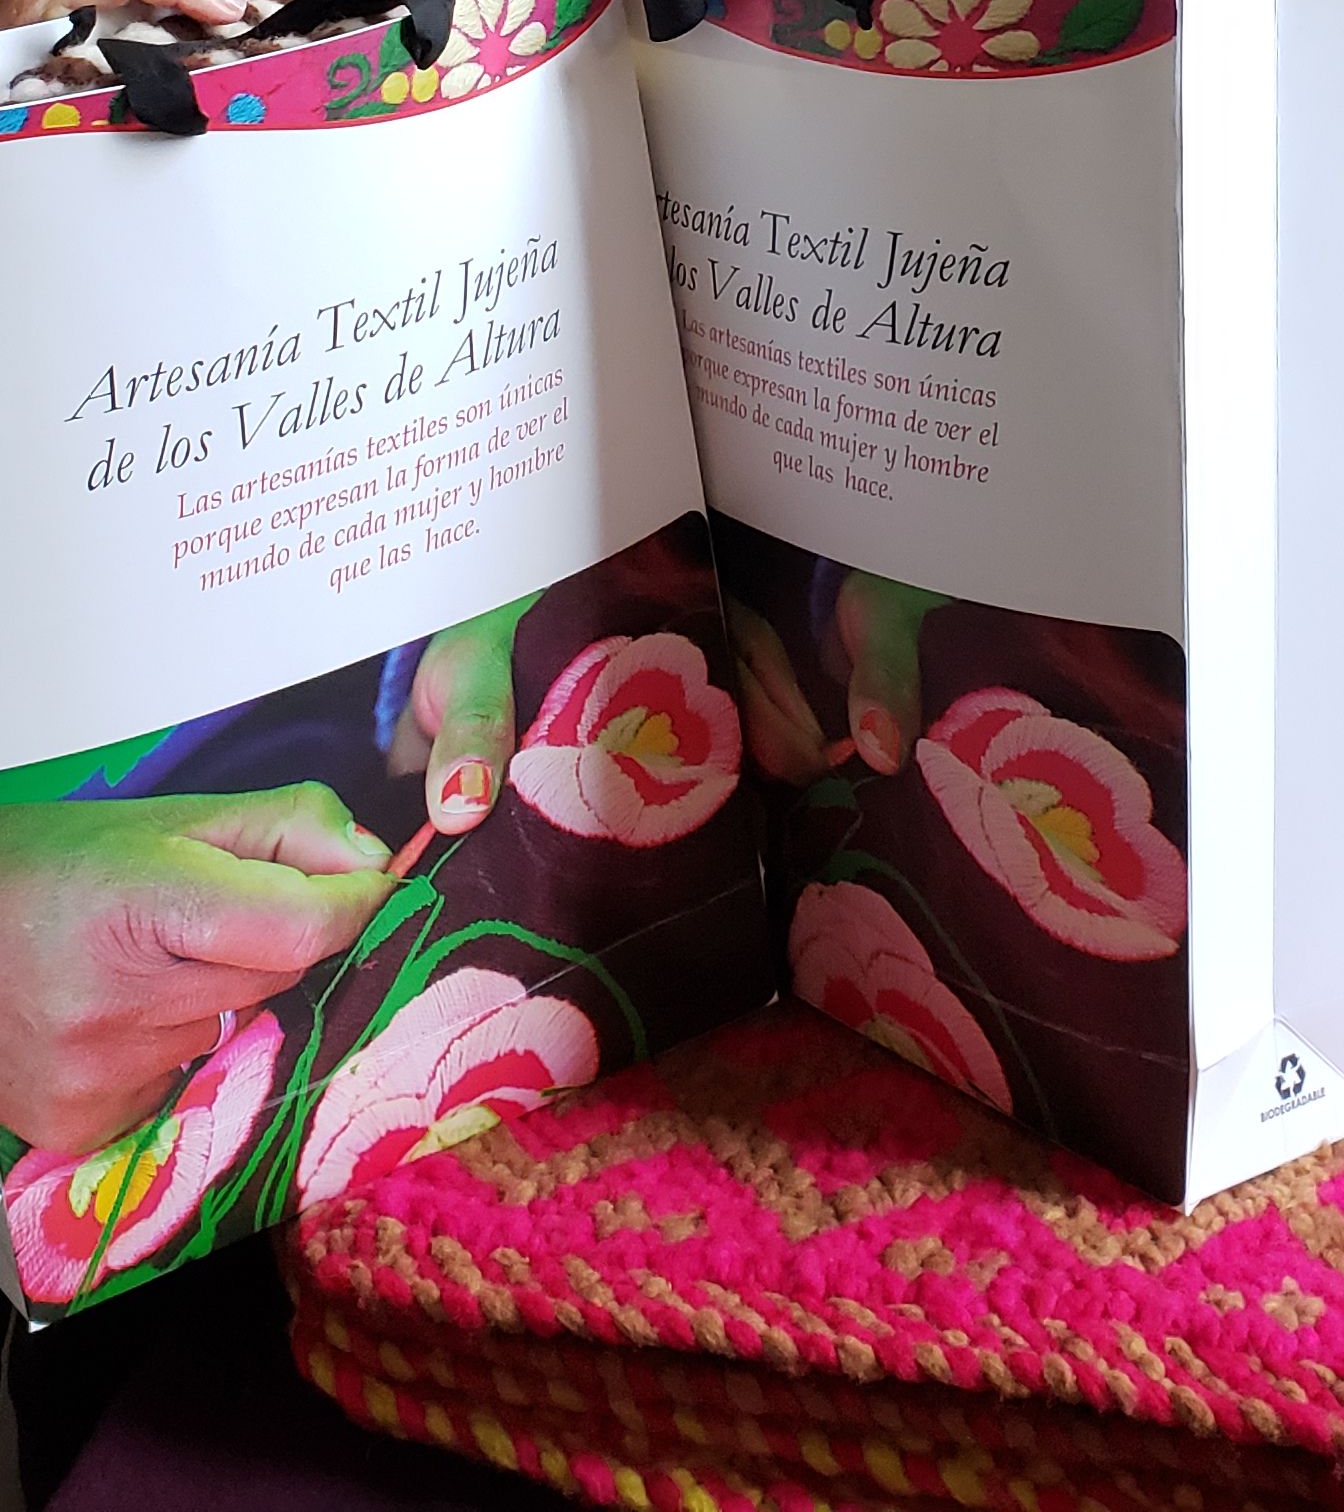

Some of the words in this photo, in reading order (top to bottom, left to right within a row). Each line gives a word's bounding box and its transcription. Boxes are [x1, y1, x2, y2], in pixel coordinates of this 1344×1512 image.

[667, 245, 698, 291] los
[707, 258, 799, 322] Valles
[812, 288, 846, 333] de
[855, 300, 1002, 358] Altura
[760, 210, 869, 270] Textil
[877, 231, 1010, 294] Jujeña
[64, 324, 301, 422] Artesanía
[317, 269, 442, 352] Textil
[453, 234, 558, 324] Jujeña
[681, 308, 706, 338] Las
[710, 327, 791, 366] artesanías
[799, 351, 866, 385] textiles
[874, 373, 910, 394] son
[919, 374, 996, 408] únicas
[88, 437, 134, 491] de
[156, 424, 213, 474] los
[231, 376, 367, 450] Valles
[384, 351, 423, 404] de
[434, 309, 560, 387] Altura
[177, 491, 221, 519] Las
[232, 447, 357, 503] artesanías
[367, 416, 447, 459] textiles
[456, 400, 490, 428] son
[499, 369, 562, 410] únicas
[733, 369, 808, 407] expresan
[814, 387, 830, 412] la
[833, 394, 896, 428] forma
[904, 409, 928, 434] de
[935, 421, 972, 442] ver
[979, 422, 998, 447] el
[753, 403, 770, 428] de
[775, 417, 813, 442] cada
[820, 431, 878, 463] mujer
[884, 446, 898, 471] y
[904, 445, 989, 483] hombre
[172, 518, 262, 569] porque
[271, 479, 379, 530] expresan
[387, 465, 406, 491] la
[411, 442, 480, 491] forma
[488, 426, 510, 453] de
[516, 414, 547, 440] ver
[554, 397, 568, 424] el
[200, 543, 289, 591] mundo
[300, 531, 325, 559] de
[335, 511, 386, 546] cada
[394, 486, 462, 526] mujer
[469, 478, 482, 506] y
[490, 444, 564, 490] hombre
[773, 449, 803, 474] que
[808, 455, 833, 483] las
[846, 466, 893, 501] hace.
[330, 558, 371, 594] que
[379, 543, 411, 569] las
[426, 520, 479, 552] hace.
[1260, 1087, 1325, 1122] BIODEGRADABLE
